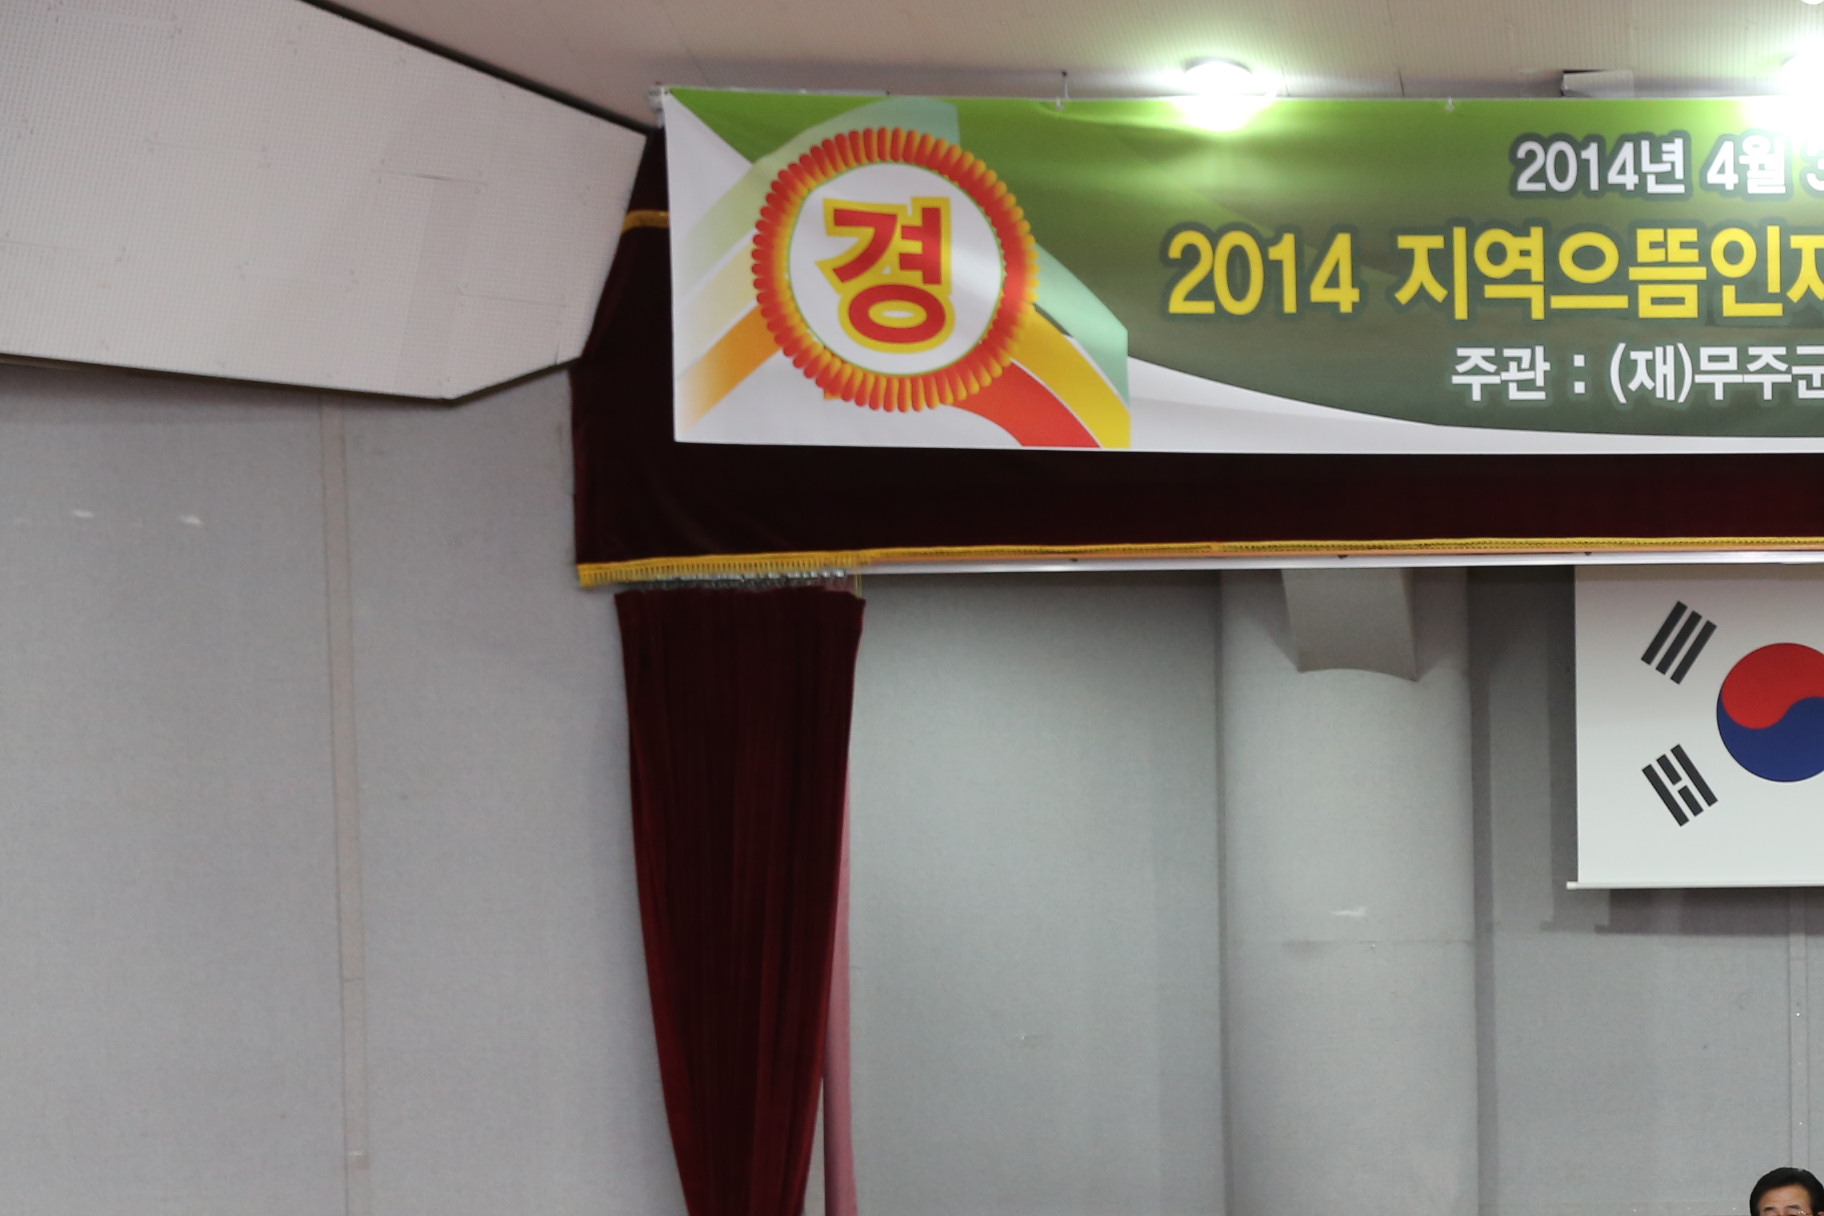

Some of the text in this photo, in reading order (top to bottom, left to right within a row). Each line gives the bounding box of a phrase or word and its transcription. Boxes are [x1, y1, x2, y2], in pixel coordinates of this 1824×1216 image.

[1516, 137, 1686, 194] 2014년
[1706, 133, 1787, 194] 4월
[826, 200, 950, 348] 경
[1168, 229, 1360, 315] 2014
[1450, 345, 1552, 402] 주관
